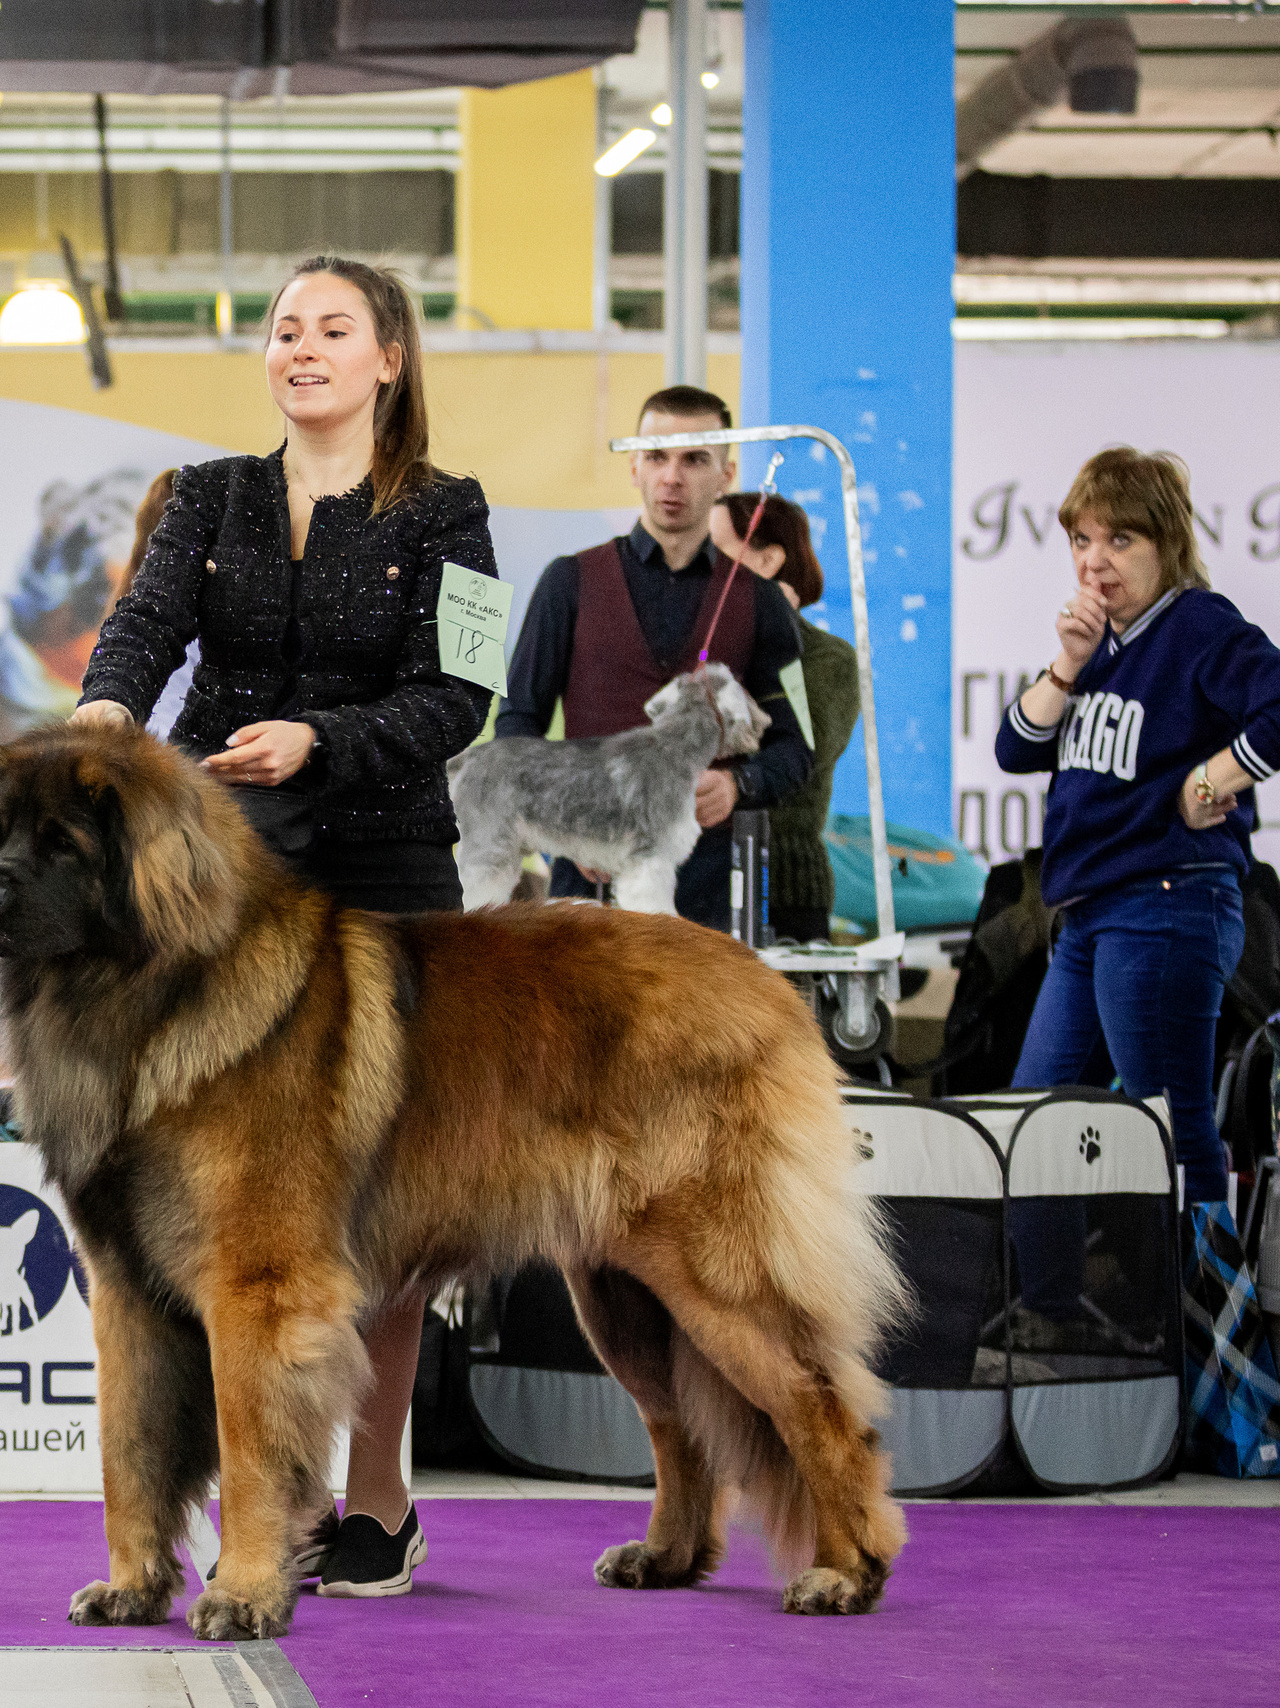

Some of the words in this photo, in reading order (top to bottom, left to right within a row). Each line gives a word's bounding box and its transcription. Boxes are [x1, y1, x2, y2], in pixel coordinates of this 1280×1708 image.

[466, 609, 487, 622] Москва
[455, 628, 484, 664] 18
[1059, 692, 1145, 781] CAGO
[958, 790, 1046, 860] ДО
